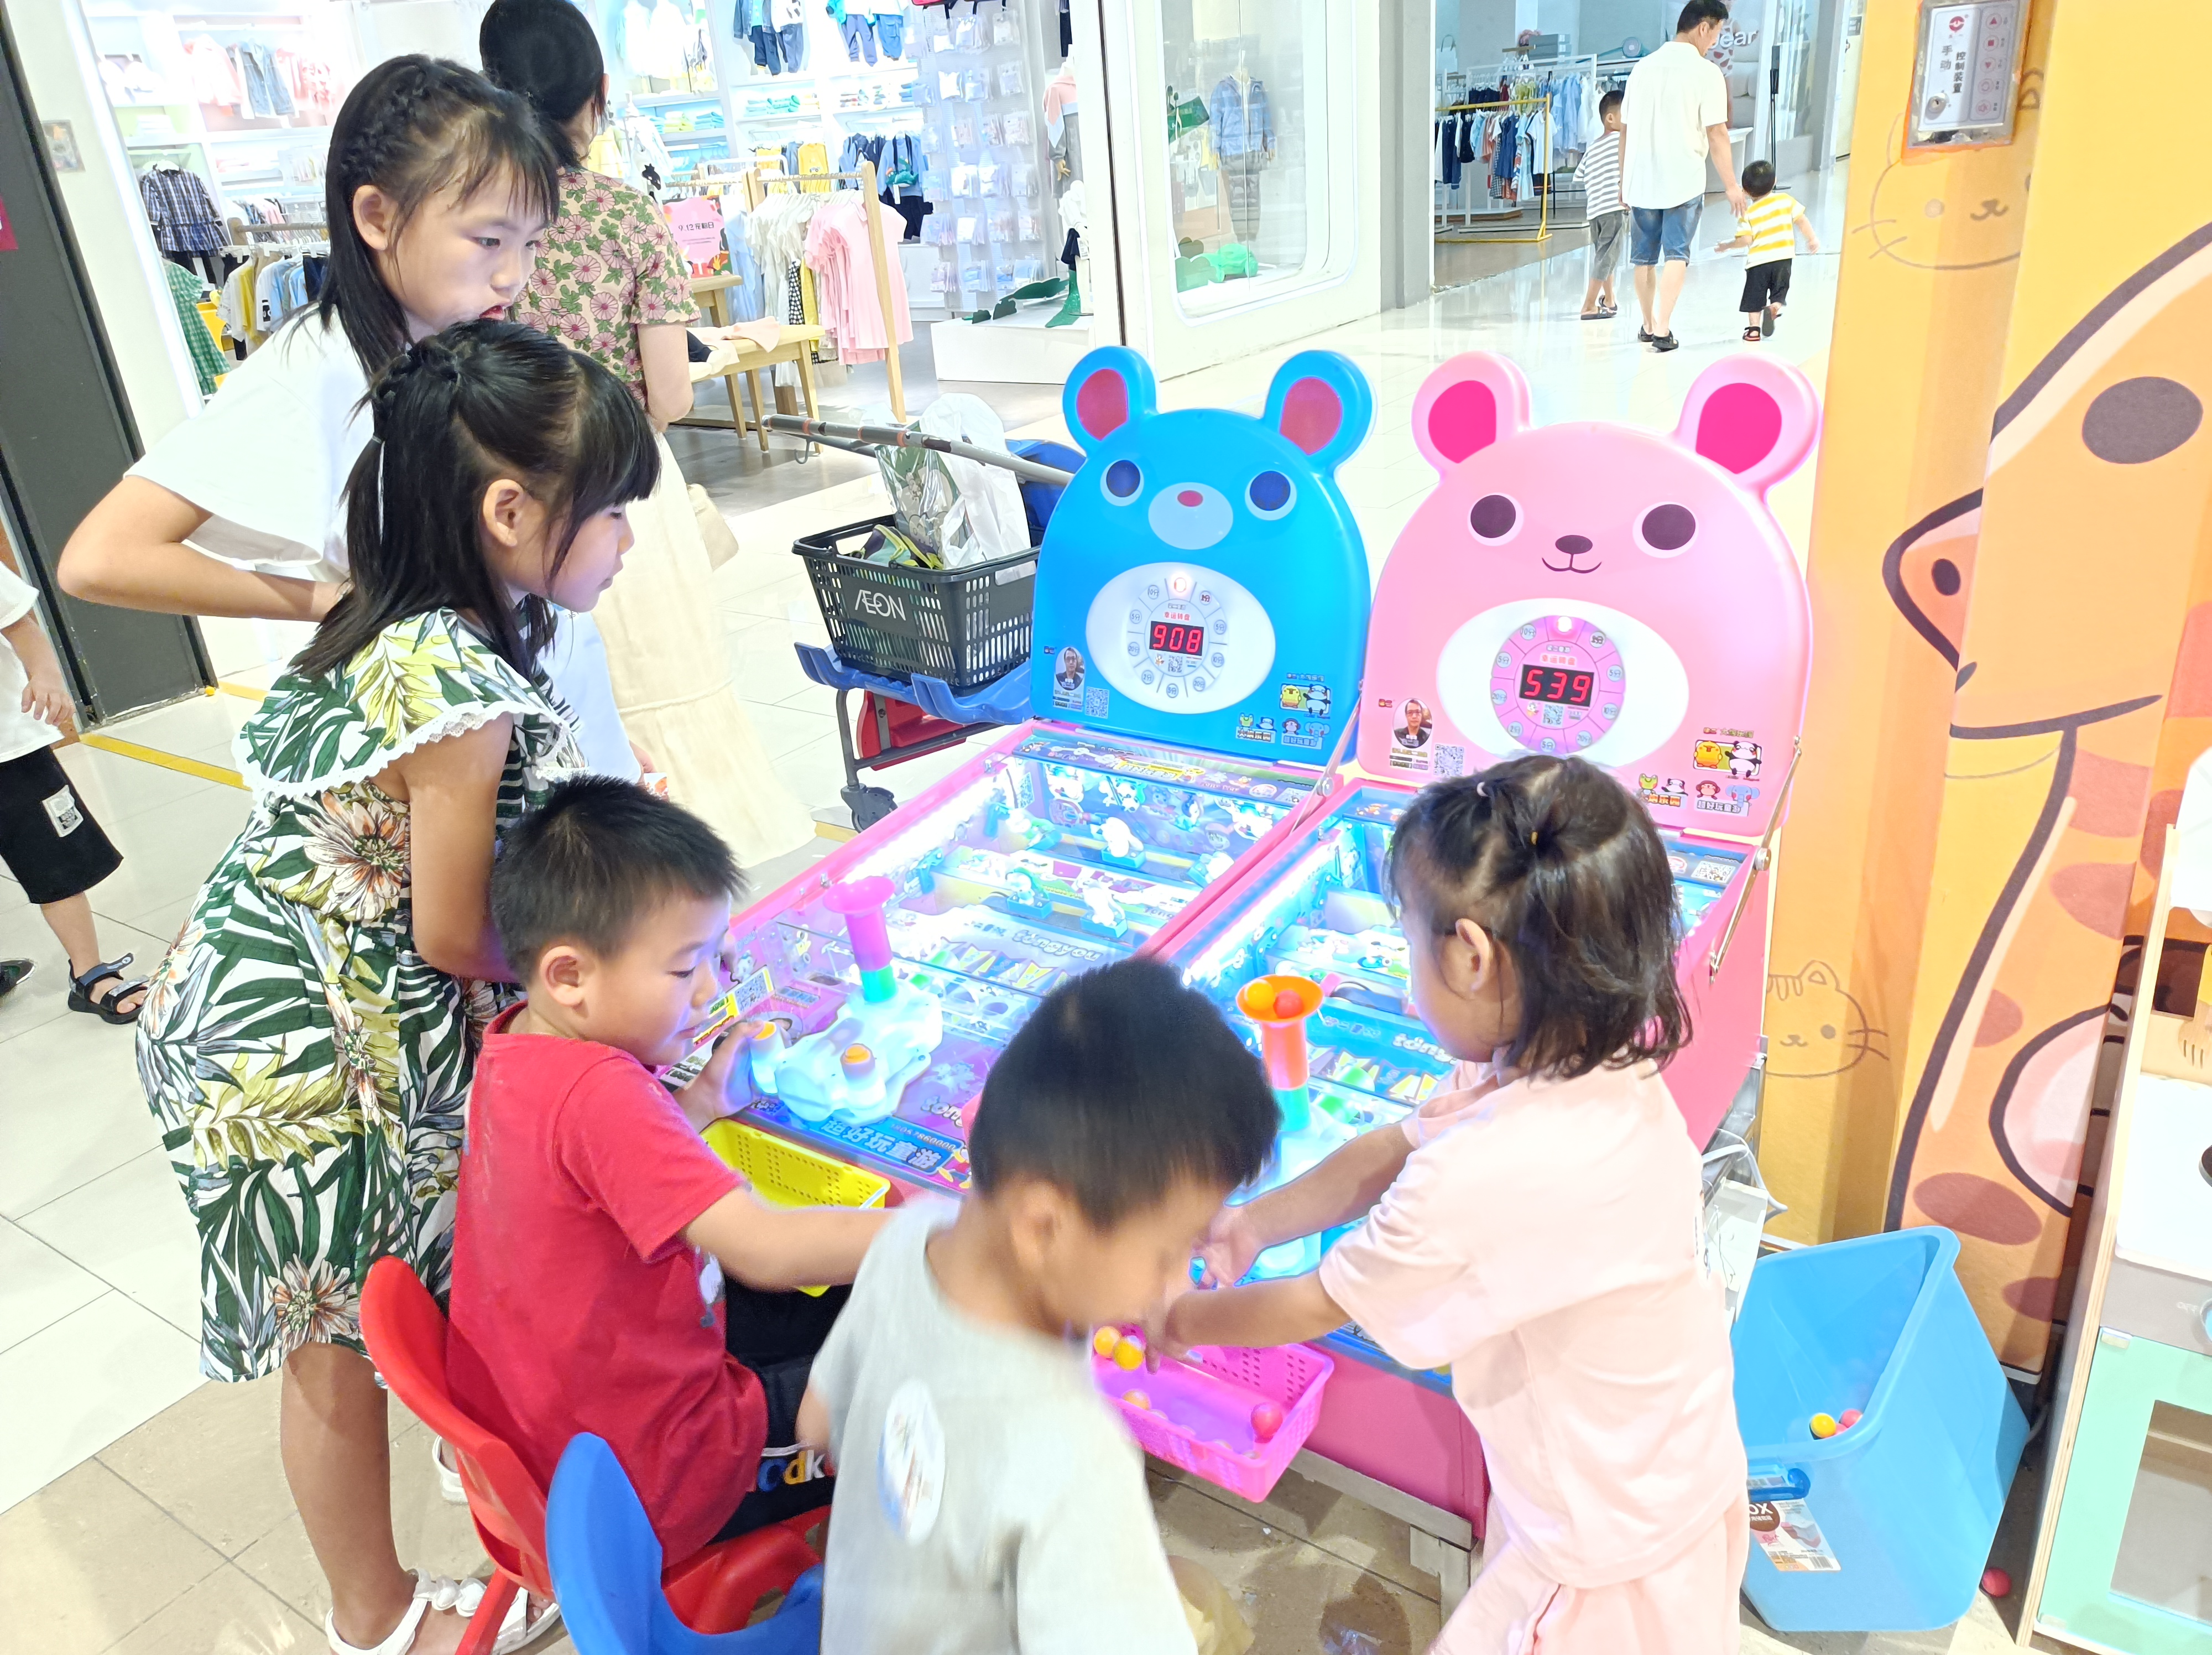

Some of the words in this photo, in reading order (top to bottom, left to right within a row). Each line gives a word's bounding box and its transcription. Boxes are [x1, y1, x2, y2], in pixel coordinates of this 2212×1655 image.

[1152, 624, 1202, 653] 908
[1524, 669, 1591, 702] 539
[821, 1118, 942, 1169] 超好玩童游
